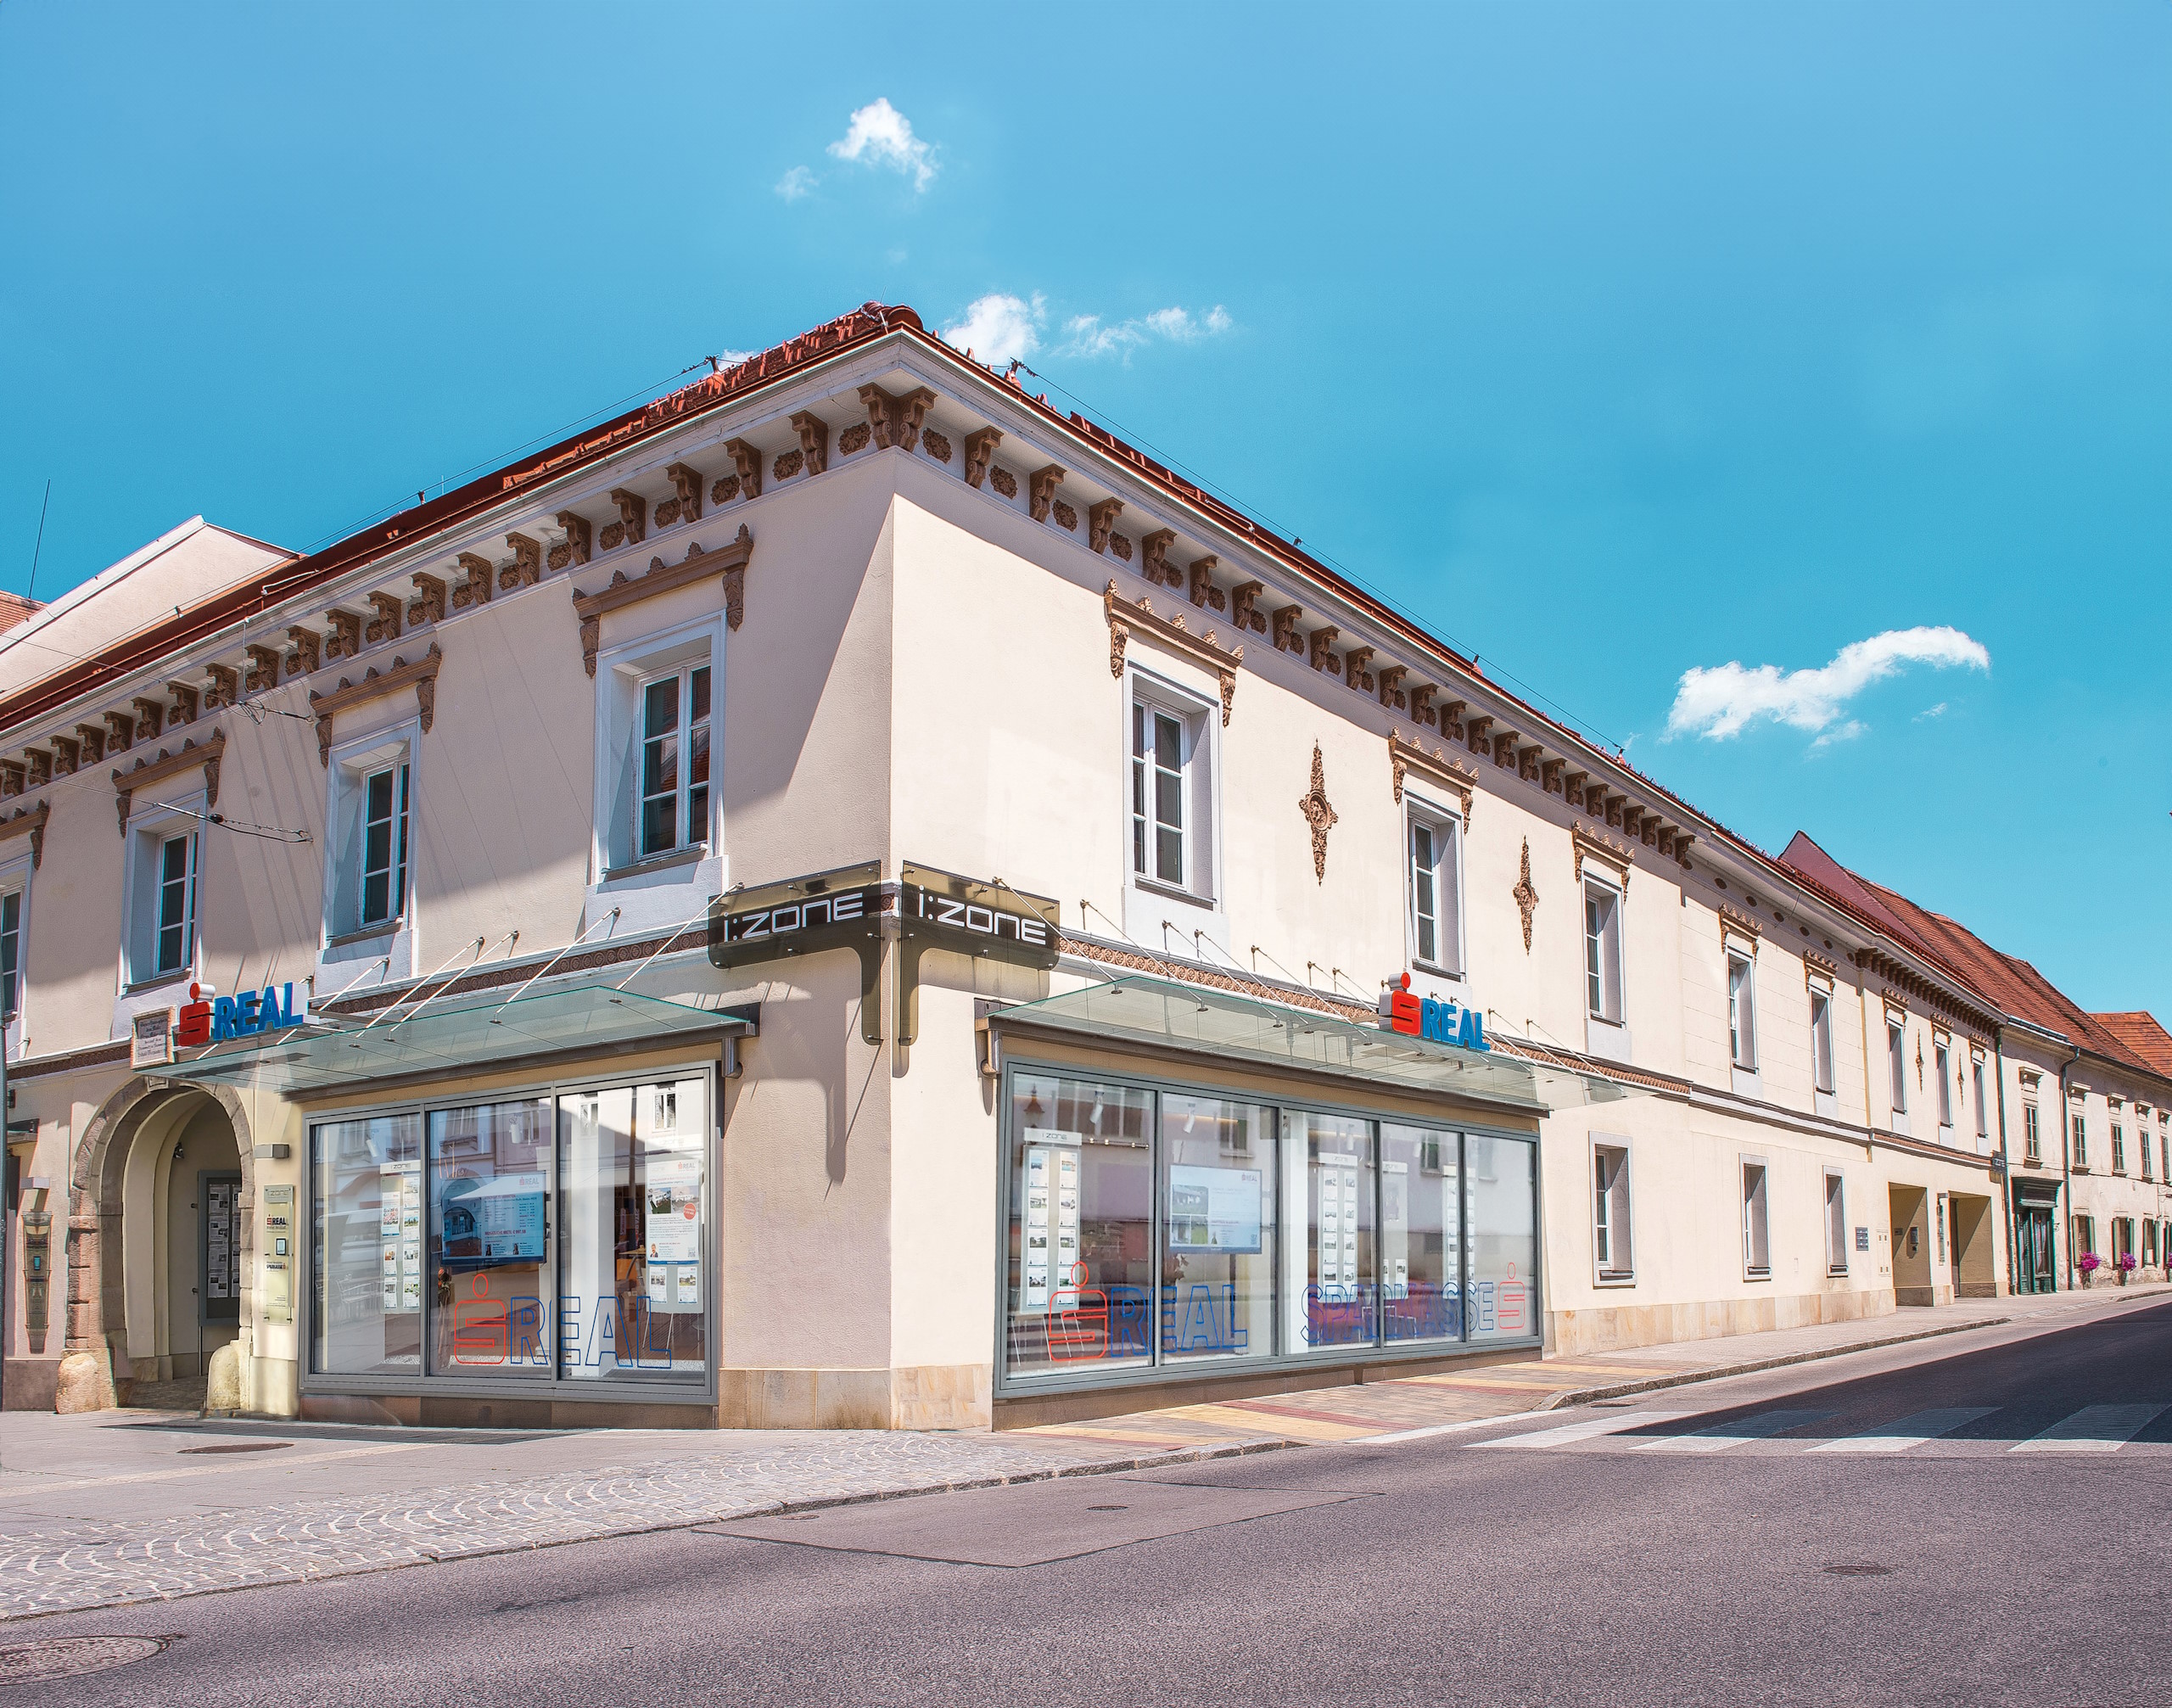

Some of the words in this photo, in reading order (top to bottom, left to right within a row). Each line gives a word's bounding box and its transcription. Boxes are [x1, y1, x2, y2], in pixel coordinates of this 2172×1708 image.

[214, 982, 304, 1041] REAL
[1422, 998, 1491, 1051] REAL
[511, 1296, 672, 1369] REAL
[1111, 1285, 1248, 1358] REAL
